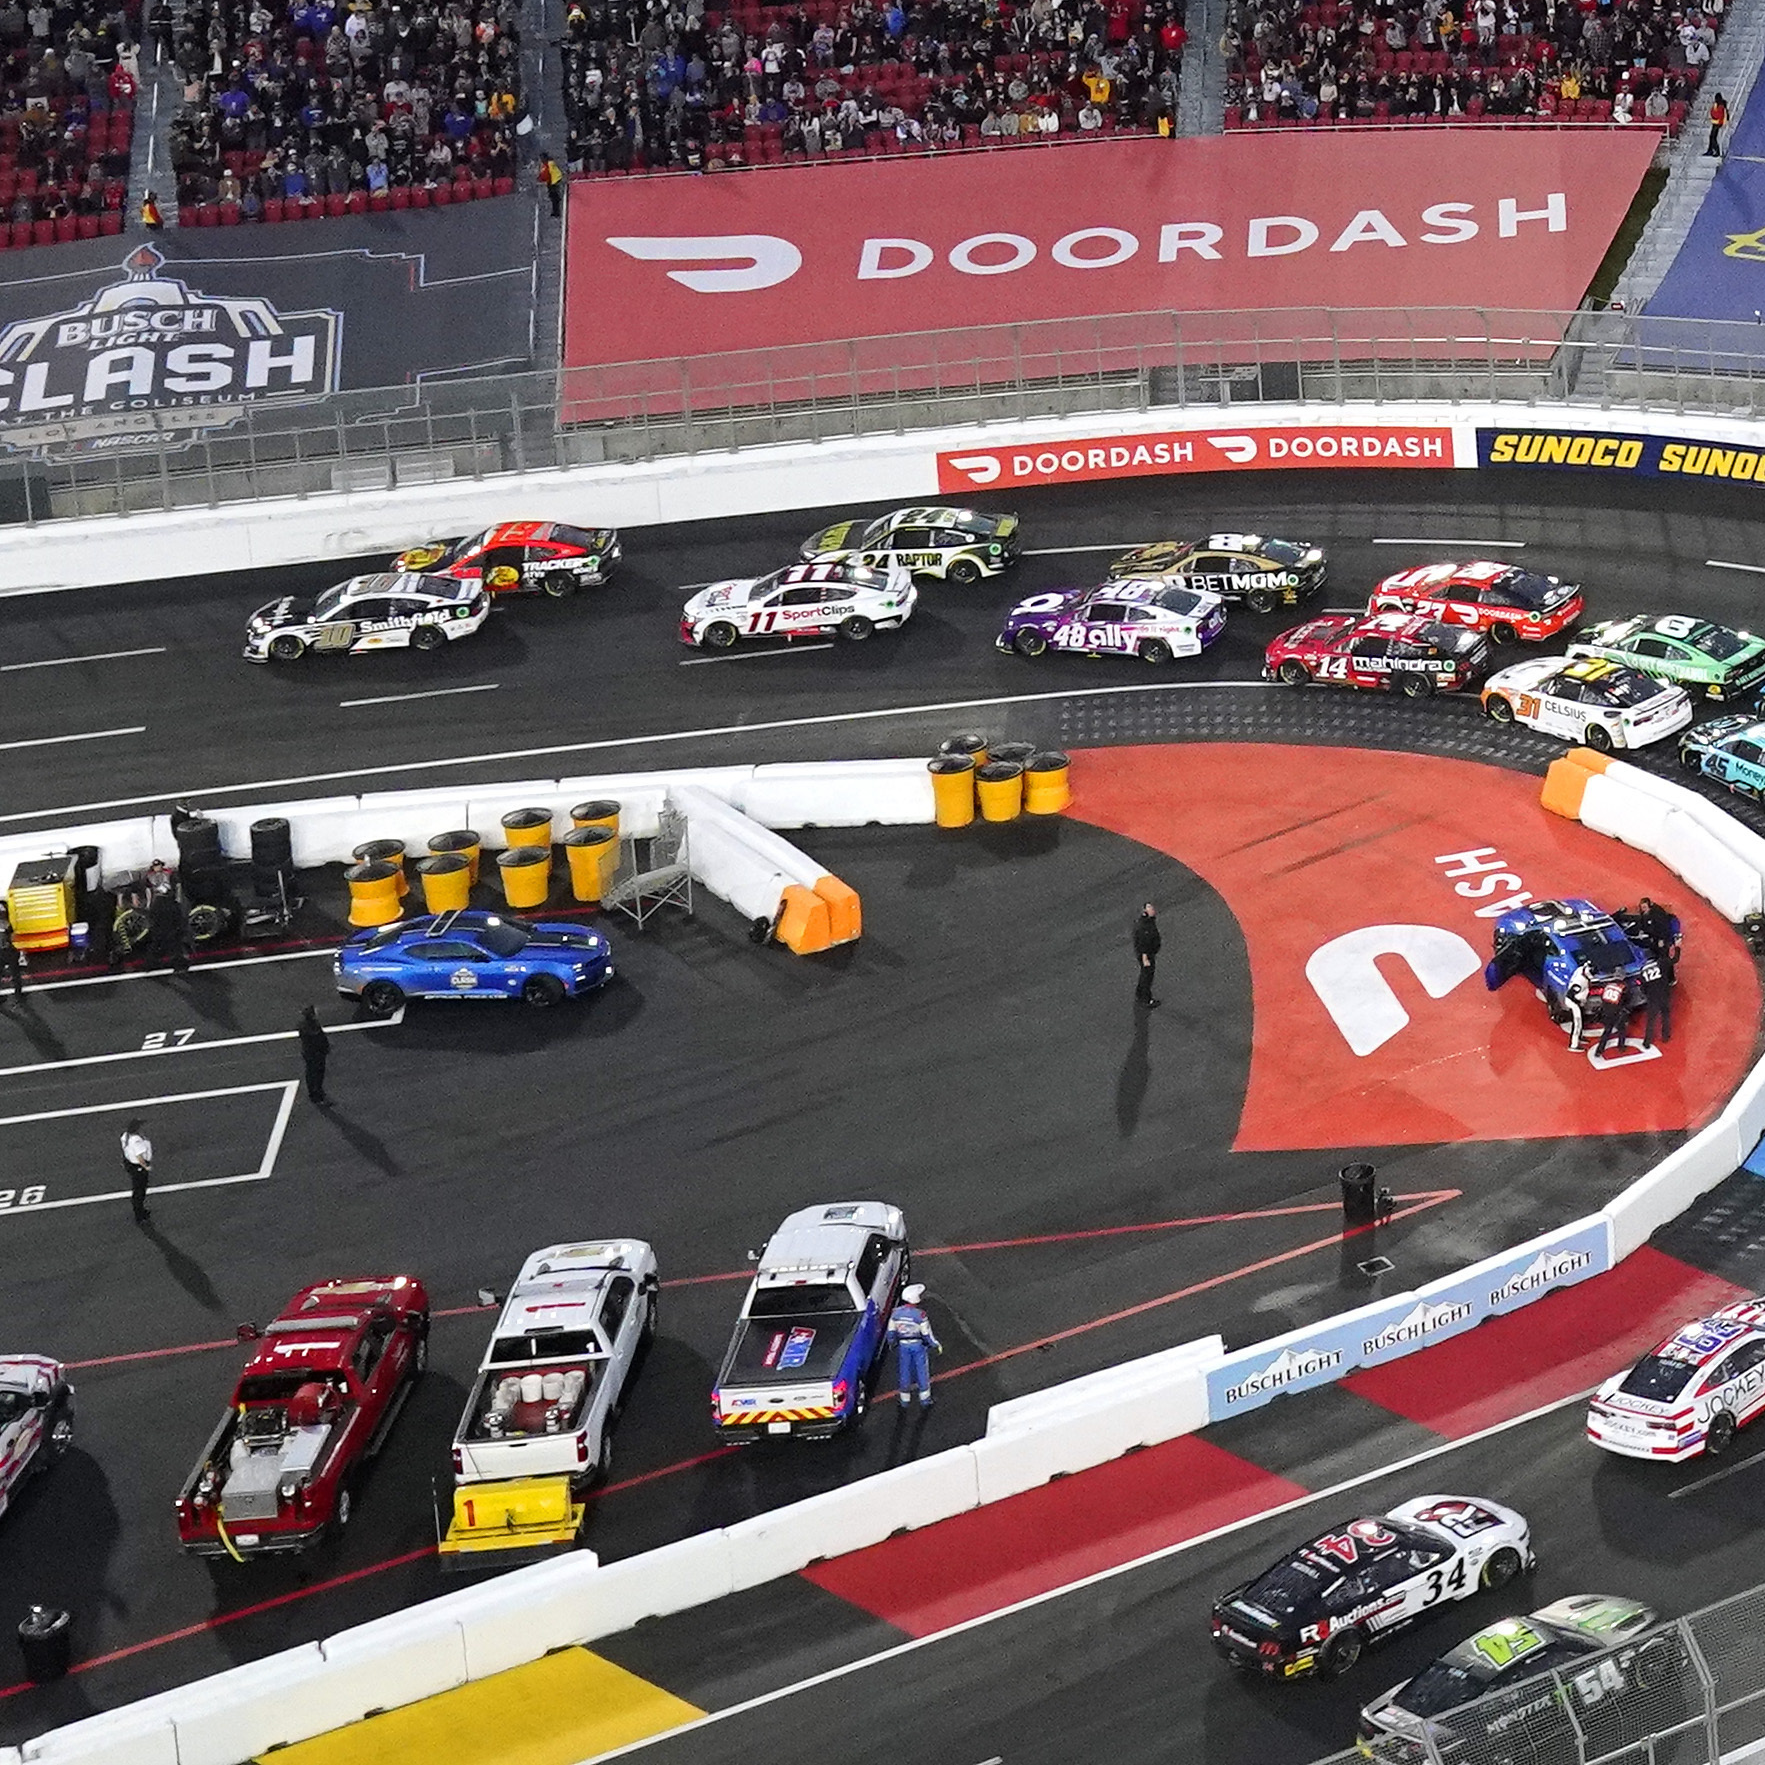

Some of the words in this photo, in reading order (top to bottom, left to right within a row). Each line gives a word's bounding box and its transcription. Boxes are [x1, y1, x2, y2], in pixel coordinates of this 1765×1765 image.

[856, 192, 1568, 280] DOORDASH
[55, 308, 219, 348] BUSCH
[88, 331, 179, 351] LIGHT
[110, 392, 257, 410] COLISEUM
[1012, 440, 1195, 477] DOORDASH
[1267, 435, 1444, 462] DOORDASH
[1489, 435, 1644, 468] SUNOCO
[522, 557, 583, 573] TRACKER
[896, 553, 942, 567] RAPTOR
[360, 609, 452, 633] Smithfield
[748, 611, 777, 633] 11
[1478, 608, 1523, 620] DOORDASH
[1053, 624, 1087, 647] 48
[1088, 623, 1137, 652] ally
[1316, 657, 1348, 679] 14
[1353, 657, 1443, 672] mahindra
[1516, 694, 1541, 719] 31
[1545, 701, 1588, 722] CELSIUS
[1705, 753, 1730, 778] 45
[1642, 967, 1662, 982] 122
[141, 1028, 196, 1050] 27
[1490, 1277, 1541, 1306] BUSCH
[1541, 1250, 1593, 1285] LIGHT
[1363, 1325, 1420, 1355] BUSCH
[1420, 1301, 1474, 1334] LIGHT
[1225, 1373, 1284, 1403] BUSCH
[1285, 1350, 1343, 1384] LIGHT
[1608, 1395, 1670, 1414] JOCKEY
[1698, 1364, 1765, 1423] JOCKEY
[1315, 1518, 1397, 1564] 34
[1423, 1557, 1467, 1606] 34
[1573, 1660, 1625, 1706] 54
